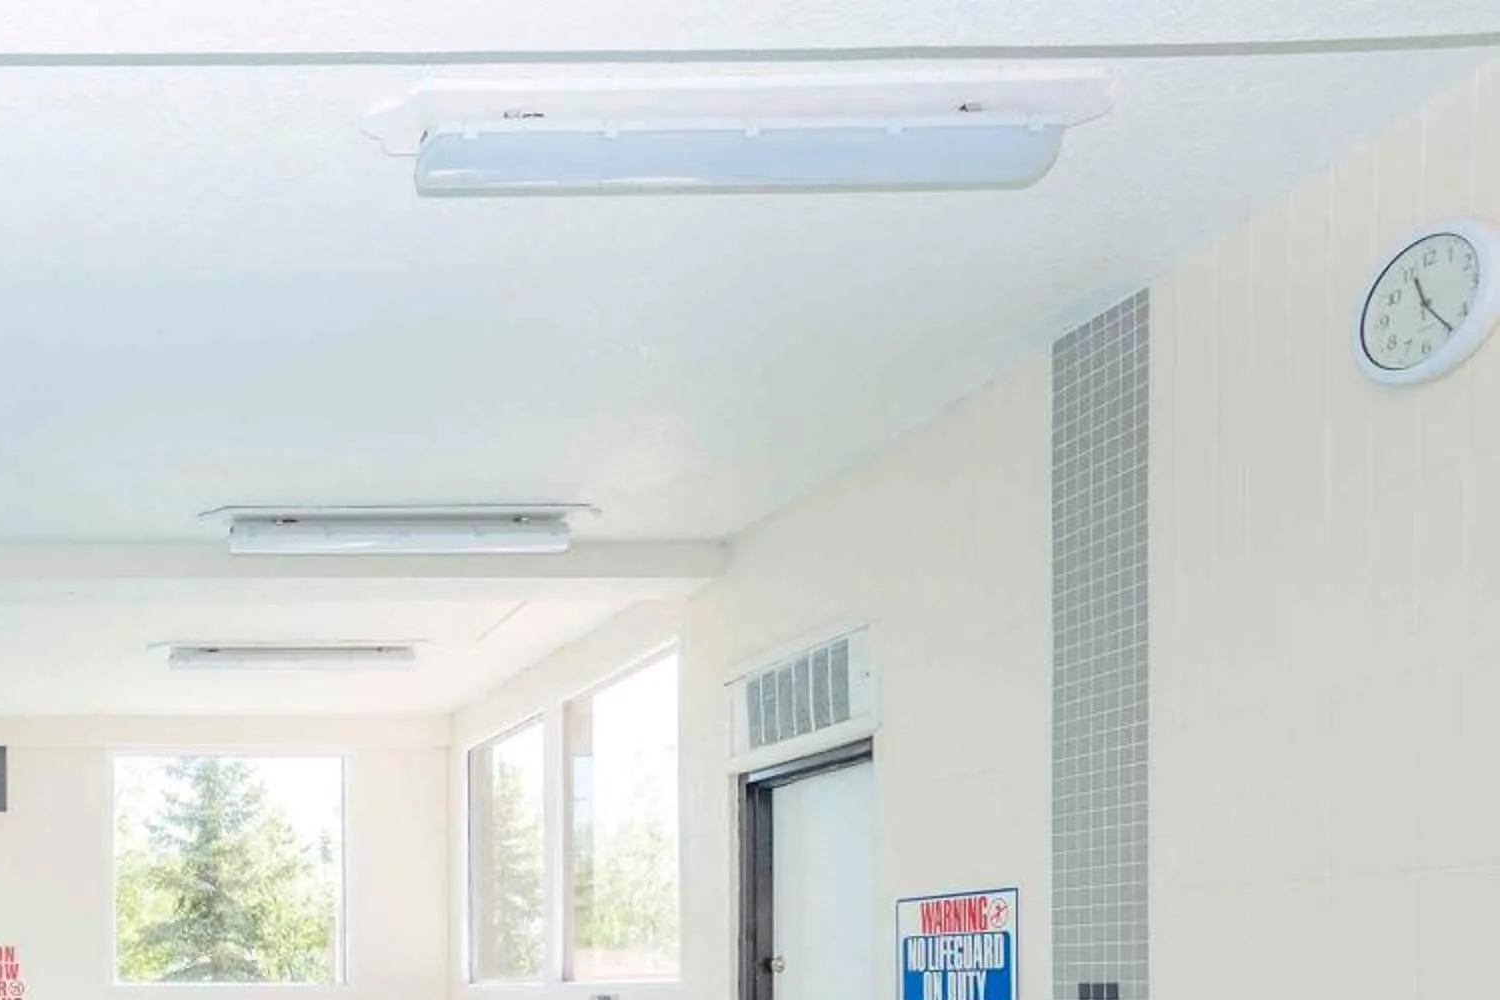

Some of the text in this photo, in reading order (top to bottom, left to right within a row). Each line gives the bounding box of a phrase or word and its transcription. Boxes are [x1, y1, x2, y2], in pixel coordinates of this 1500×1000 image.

[920, 896, 988, 934] WARNING
[907, 934, 1005, 971] NO LIFEGUARD
